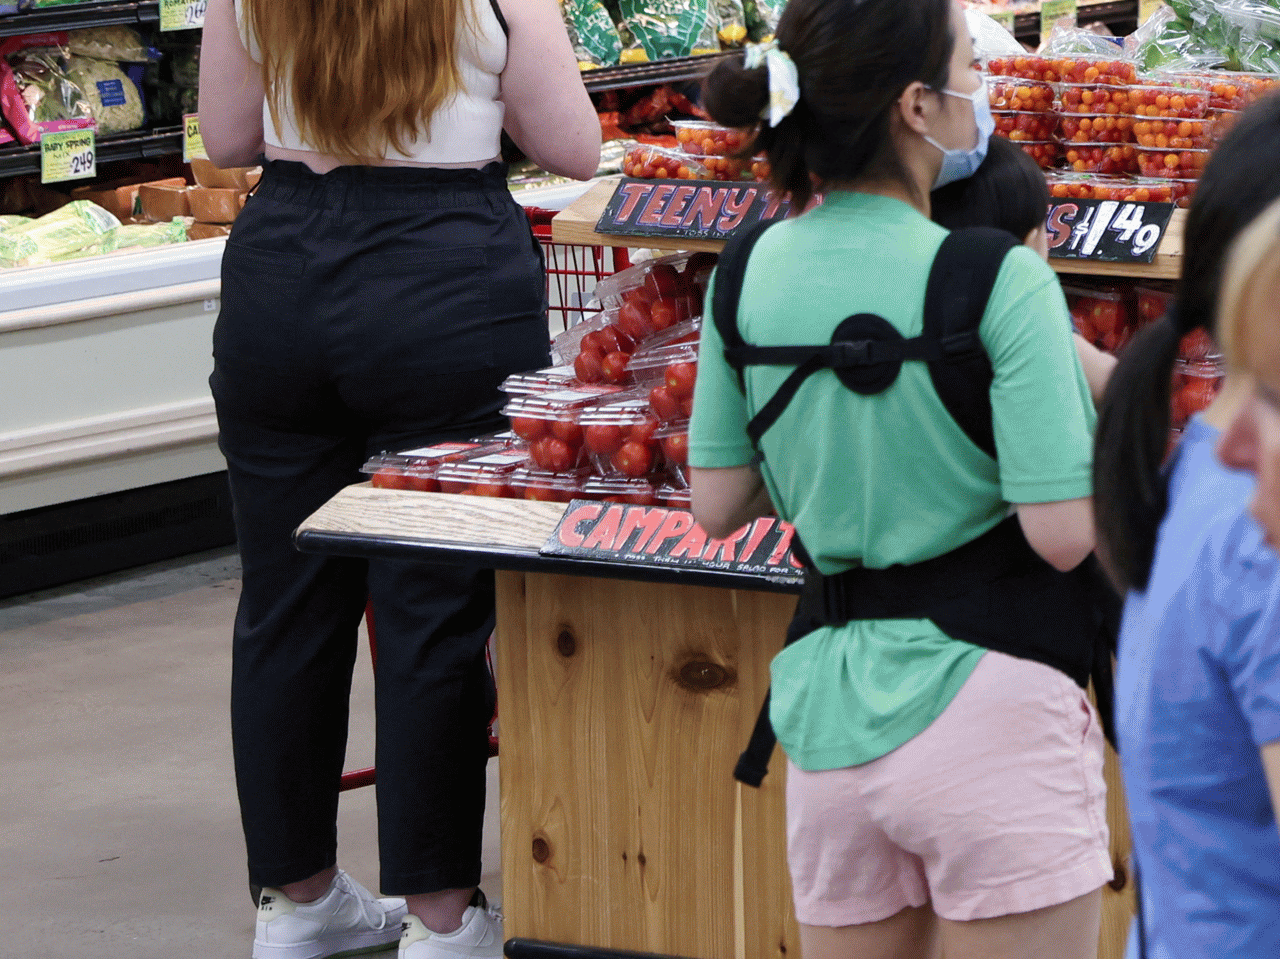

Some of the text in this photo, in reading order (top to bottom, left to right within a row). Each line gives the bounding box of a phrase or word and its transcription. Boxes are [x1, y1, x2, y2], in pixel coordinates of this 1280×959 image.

[44, 137, 92, 153] BABY SPRING
[613, 183, 757, 232] TEENY
[736, 563, 767, 573] SALAD
[769, 566, 789, 574] FOR
